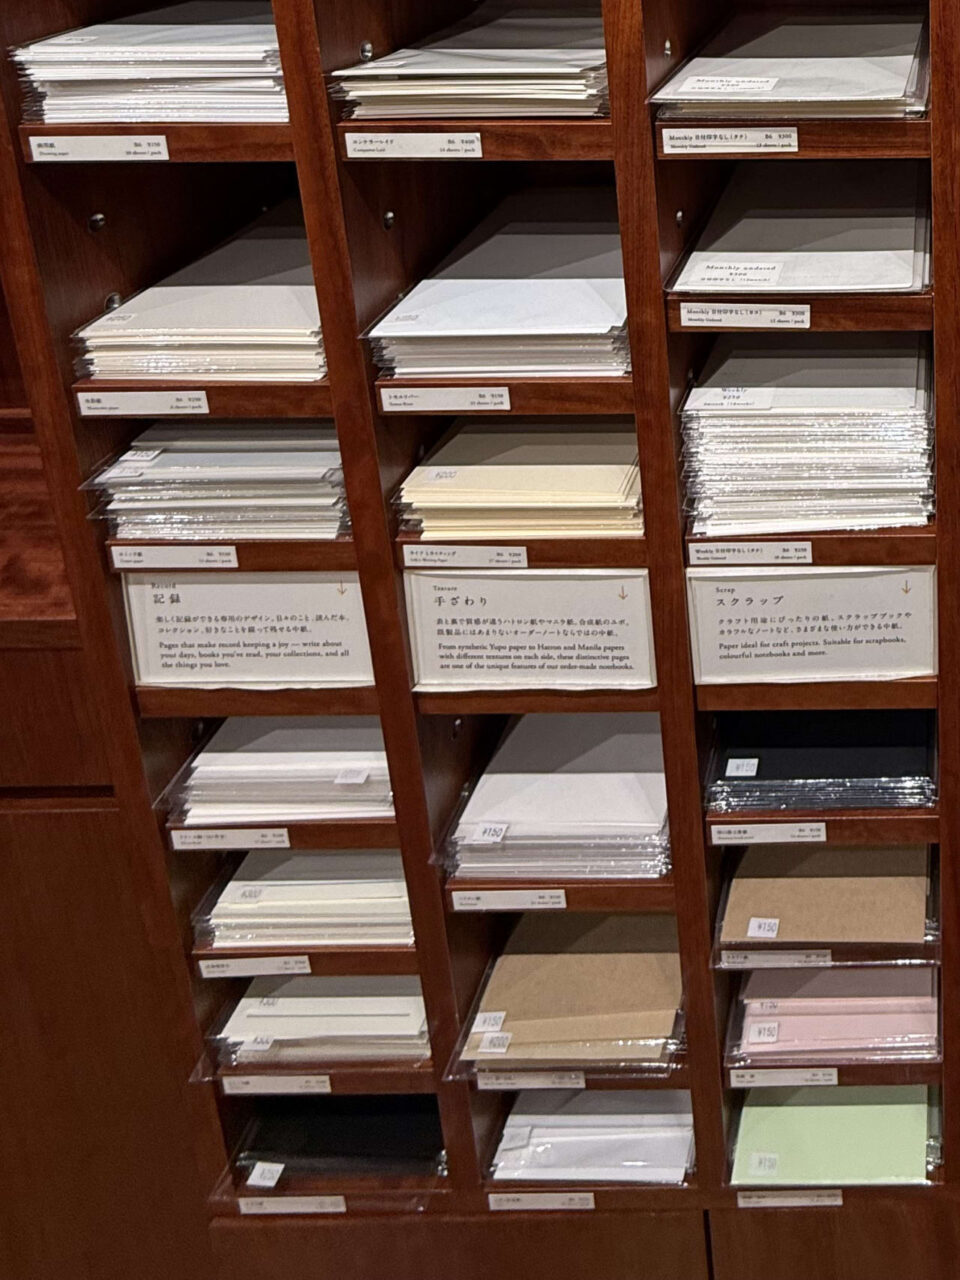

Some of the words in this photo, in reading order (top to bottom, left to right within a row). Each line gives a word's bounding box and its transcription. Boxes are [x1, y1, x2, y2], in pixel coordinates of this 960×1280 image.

[715, 586, 736, 595] Scrap
[434, 595, 487, 607] 手ざわり
[716, 594, 784, 606] スクラップ
[755, 921, 777, 934] ¥150
[757, 1025, 777, 1039] ¥150
